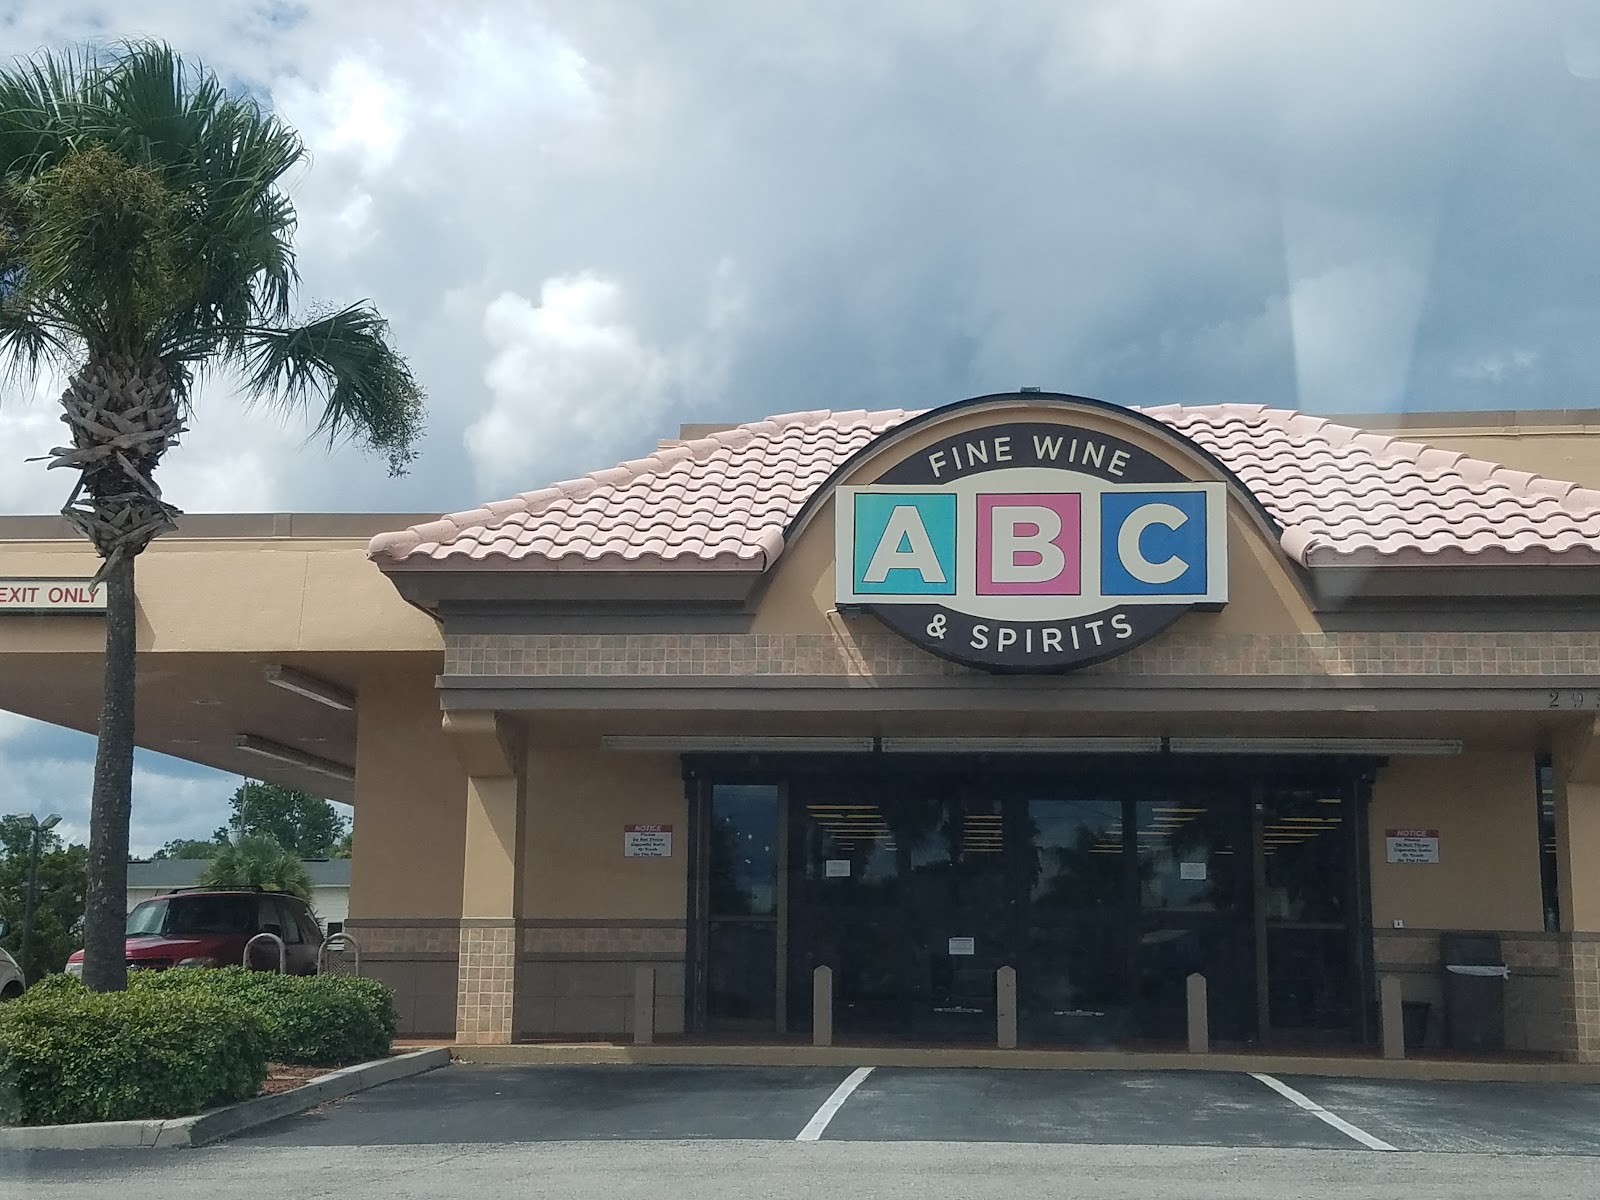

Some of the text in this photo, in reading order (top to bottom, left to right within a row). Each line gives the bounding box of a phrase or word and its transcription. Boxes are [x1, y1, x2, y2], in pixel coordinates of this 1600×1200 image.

[928, 434, 1132, 478] FINE WINE
[862, 503, 1190, 584] ABC
[0, 587, 100, 603] EXIT ONLY
[926, 613, 1133, 655] & SPIRITS
[1549, 690, 1600, 708] 29
